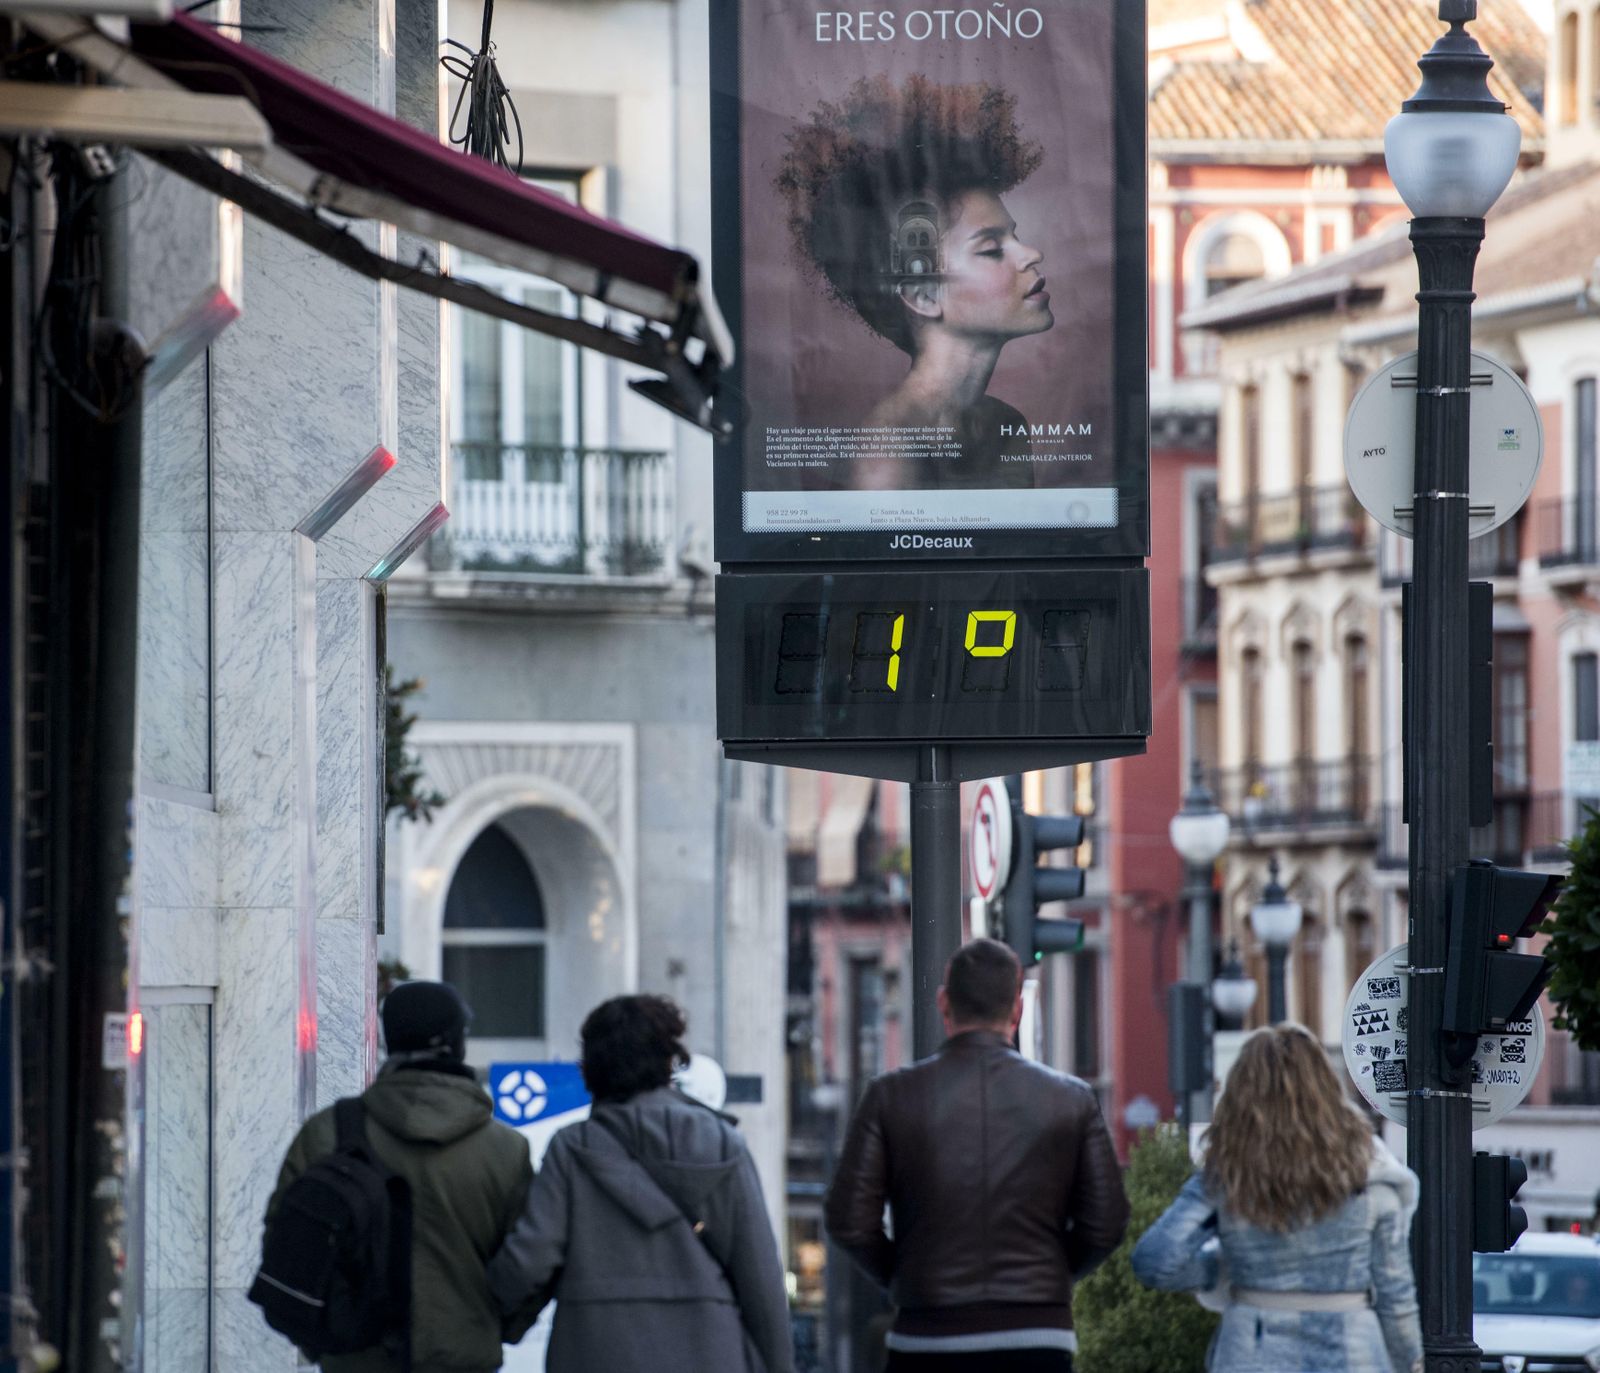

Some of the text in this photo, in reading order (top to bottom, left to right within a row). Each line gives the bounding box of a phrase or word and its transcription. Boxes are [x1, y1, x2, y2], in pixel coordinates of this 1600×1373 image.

[816, 2, 1043, 42] ERES OTOÑO
[1000, 424, 1091, 436] HAMMAM
[1363, 447, 1385, 458] AYTO
[890, 535, 972, 548] JCDecaux
